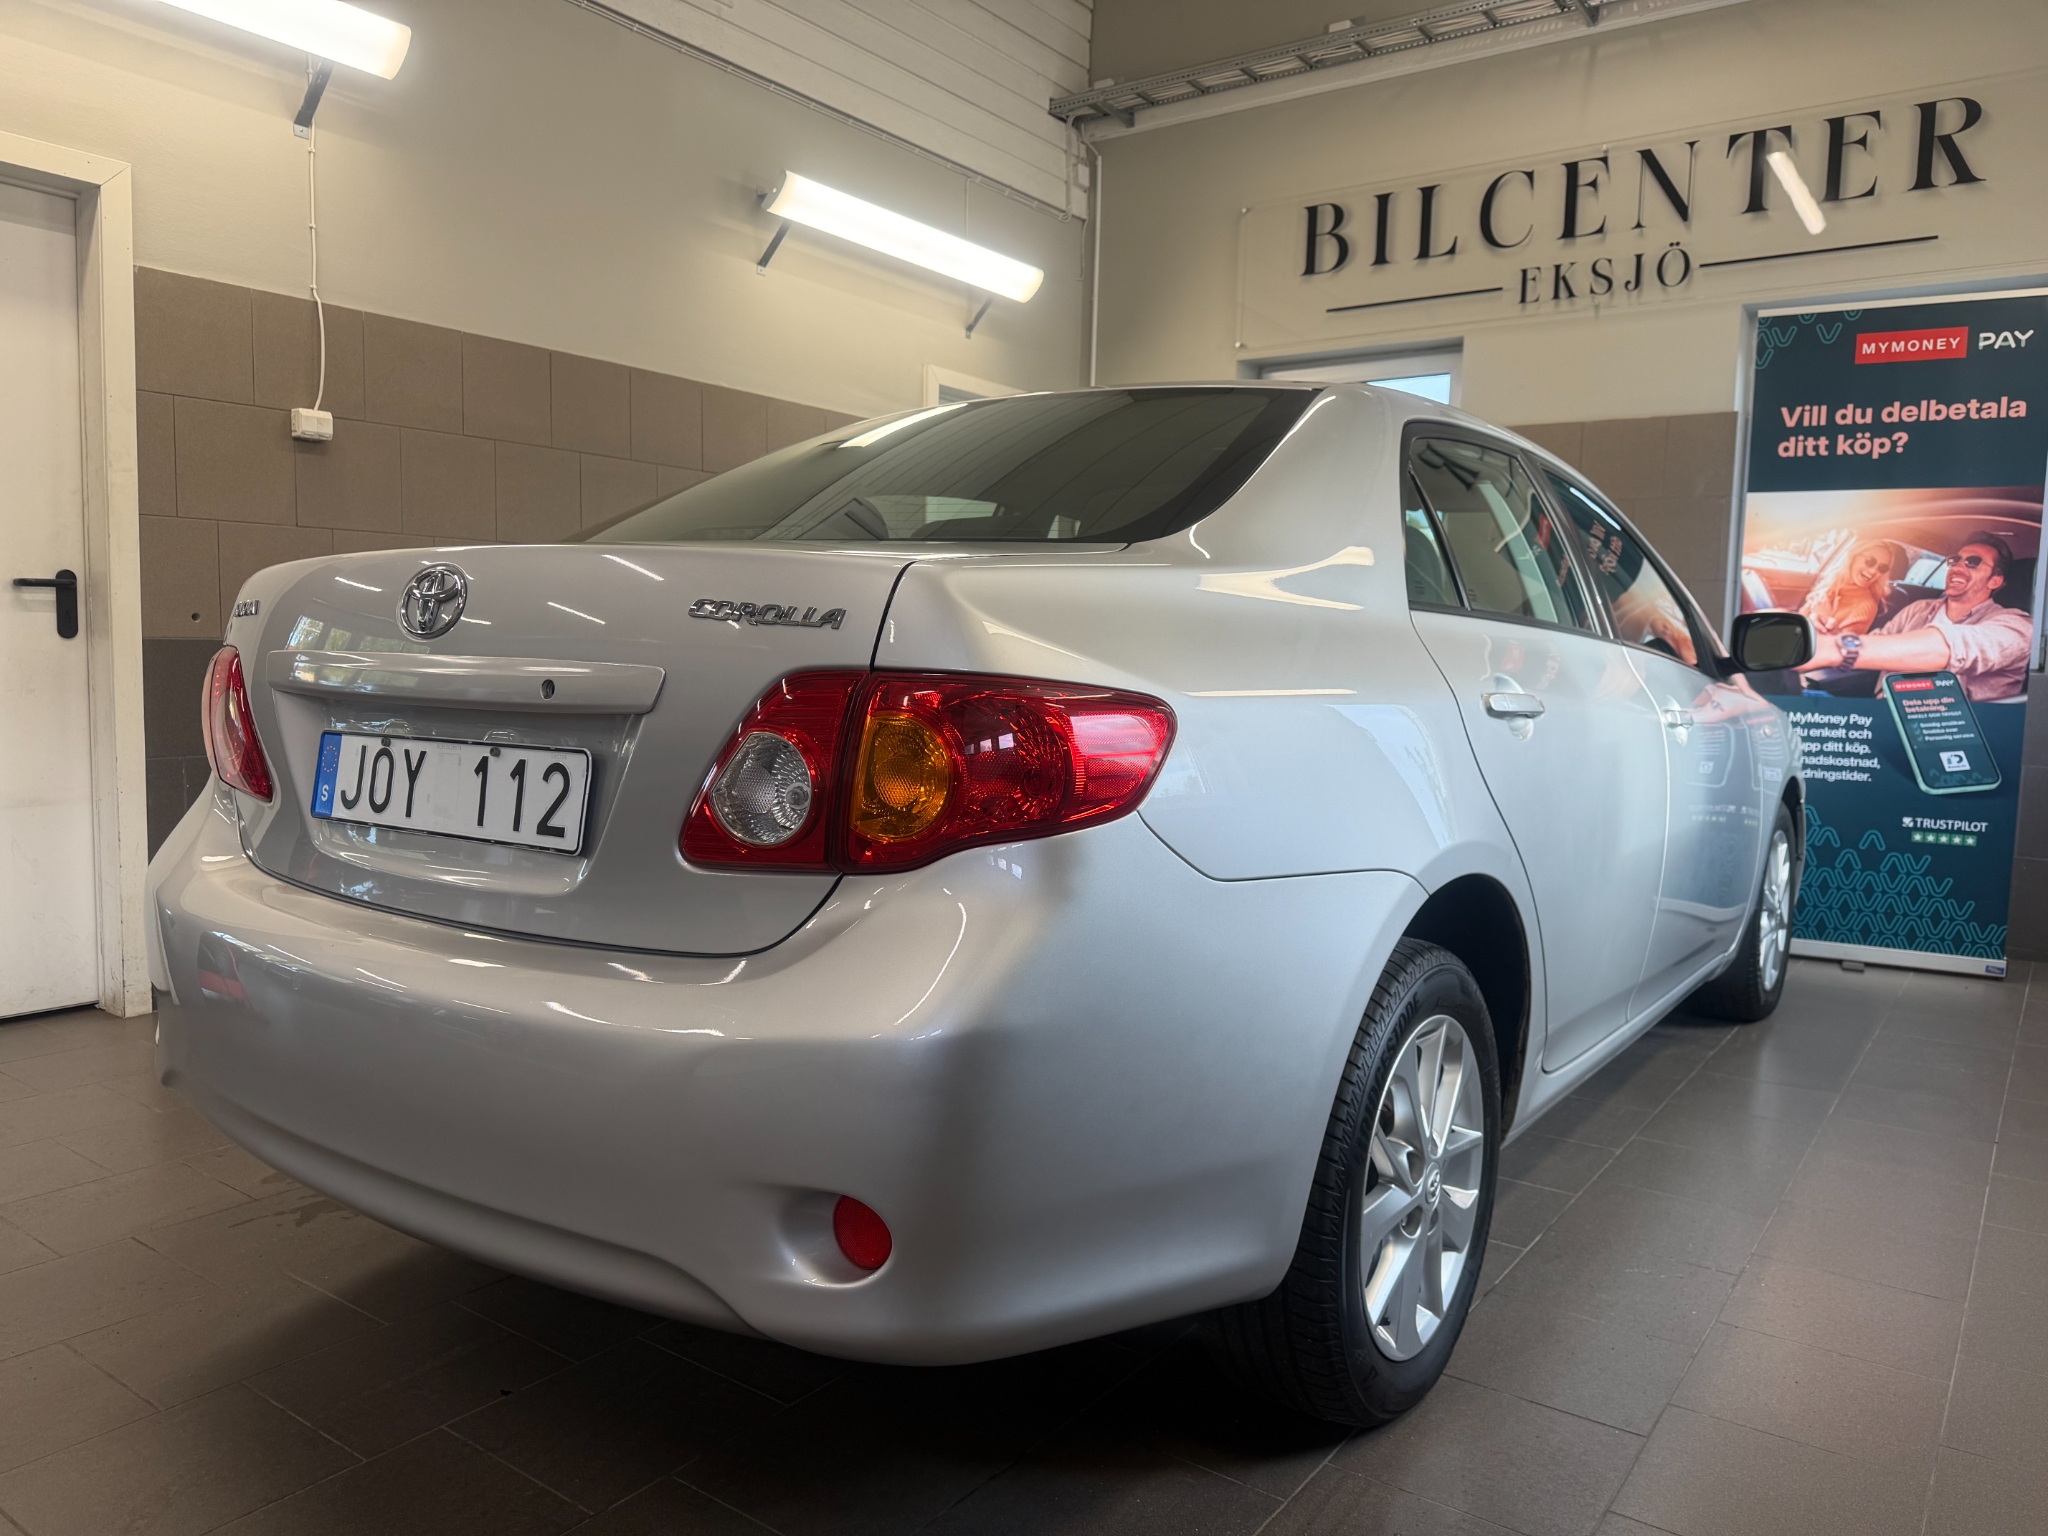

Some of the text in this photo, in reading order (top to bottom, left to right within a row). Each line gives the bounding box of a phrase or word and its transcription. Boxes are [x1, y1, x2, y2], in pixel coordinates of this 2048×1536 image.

[1301, 97, 1986, 276] BILCENTER
[1518, 242, 1690, 304] EKSJÖ
[1862, 330, 2034, 355] MYMONEY PAY
[1780, 396, 2027, 428] Vill du delbetala
[1777, 432, 1909, 459] ditt köp?
[688, 599, 846, 629] COROLLA
[1788, 711, 1873, 727] MyMoney Pay
[1809, 727, 1847, 738] enkelt
[1848, 728, 1872, 739] och
[1822, 741, 1843, 752] ditt
[1845, 742, 1871, 755] köp.
[1800, 754, 1881, 769] nadskostnad,
[1801, 768, 1872, 782] dningstider.
[320, 745, 571, 838] S JOY 112
[1915, 817, 1988, 832] TRUSTPILOT
